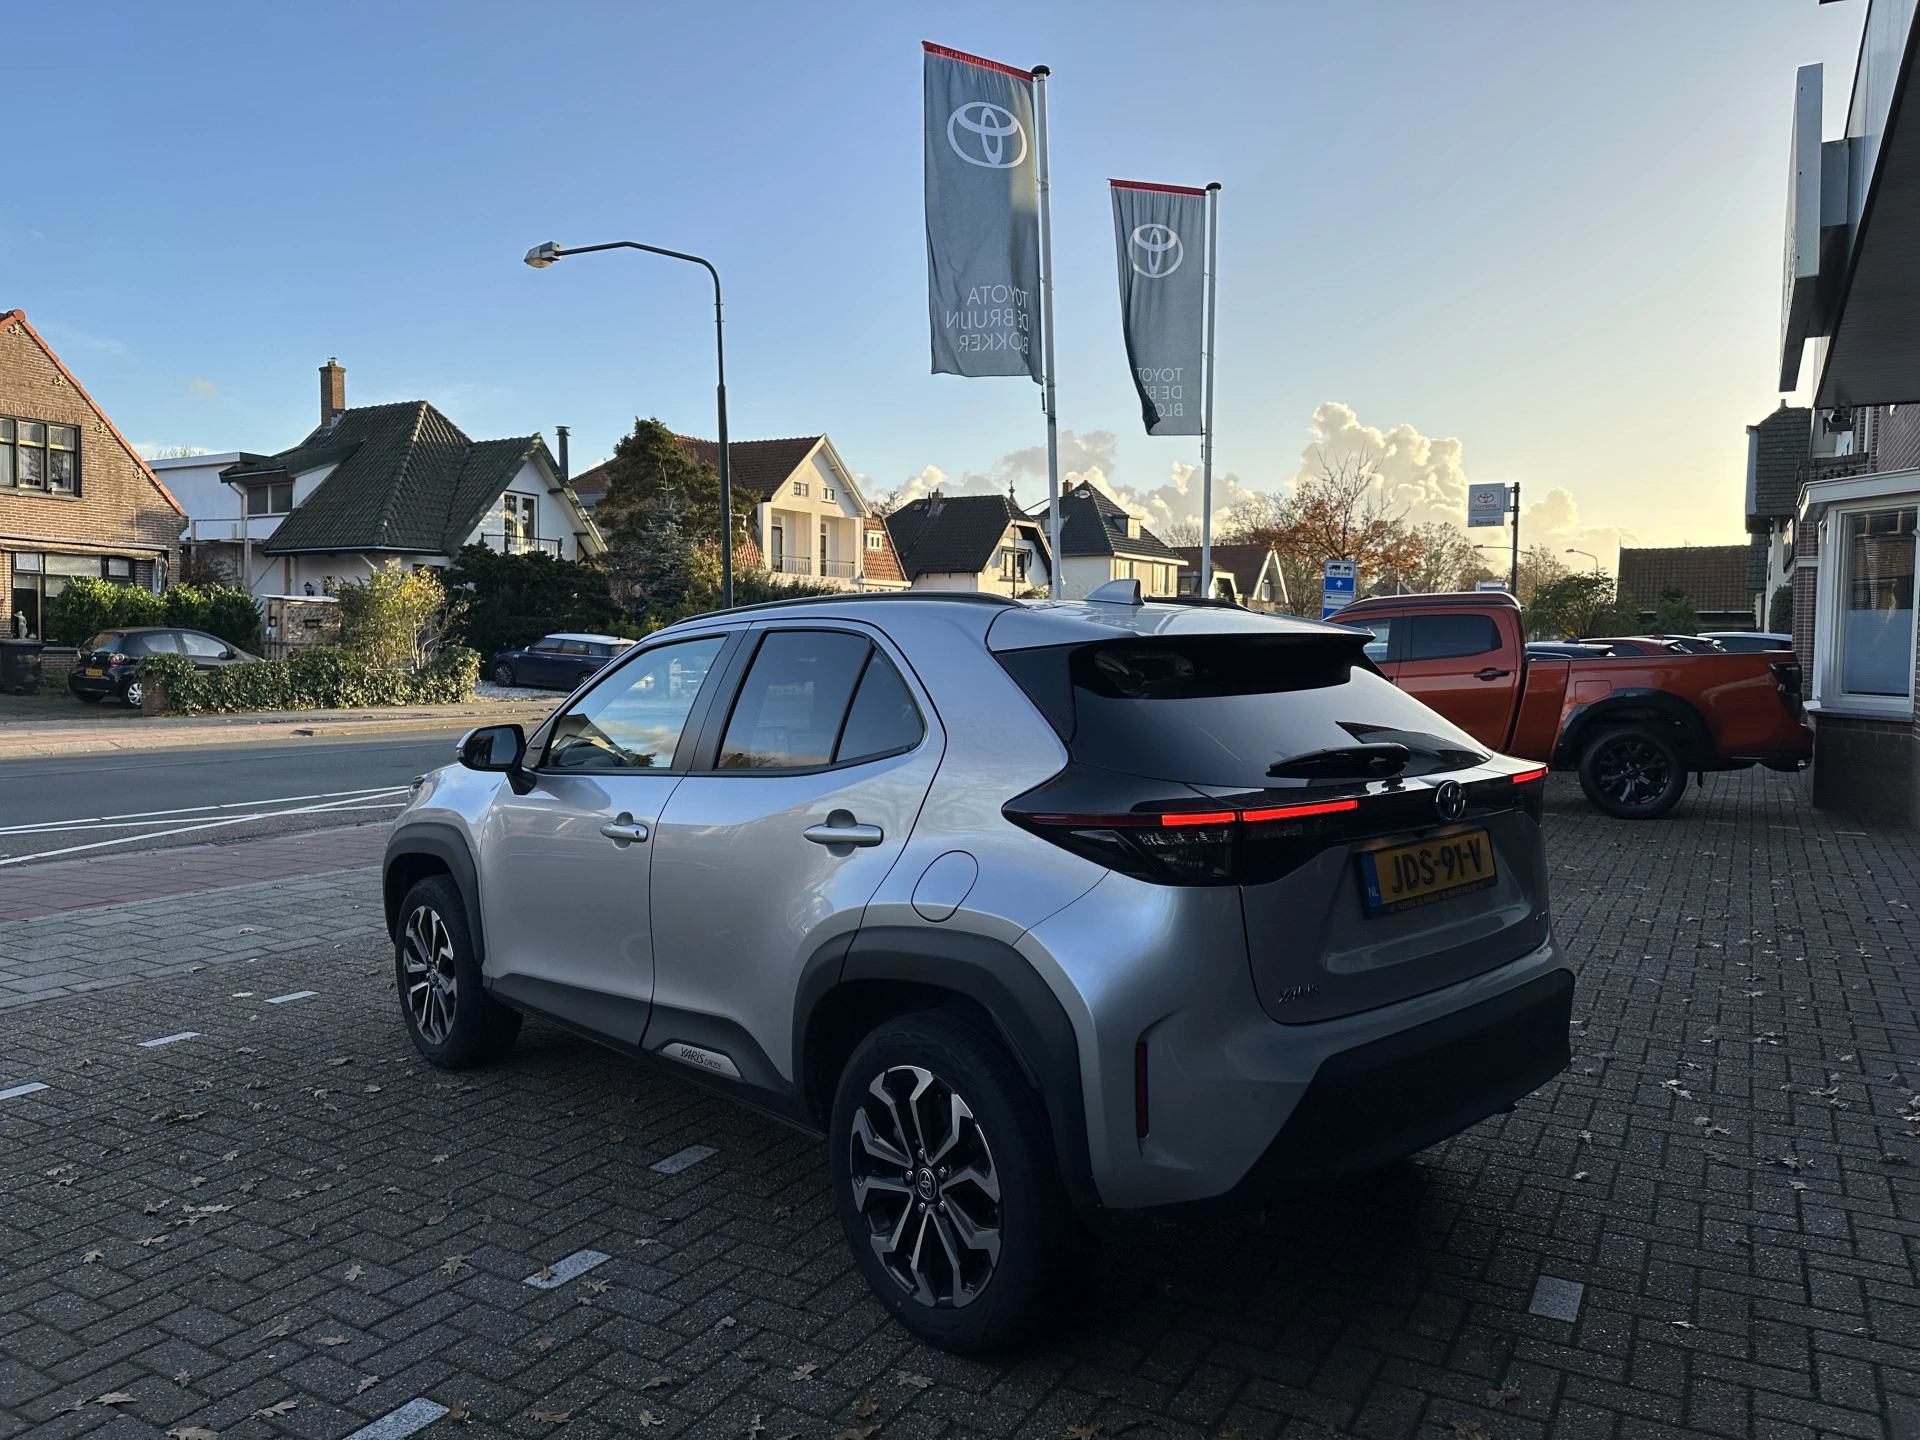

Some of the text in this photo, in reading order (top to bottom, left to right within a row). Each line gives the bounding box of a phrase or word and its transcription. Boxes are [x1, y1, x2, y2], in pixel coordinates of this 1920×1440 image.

[1391, 838, 1482, 894] JDS-91-V
[1367, 886, 1380, 898] NL
[680, 1046, 721, 1070] YARIS CROSS
